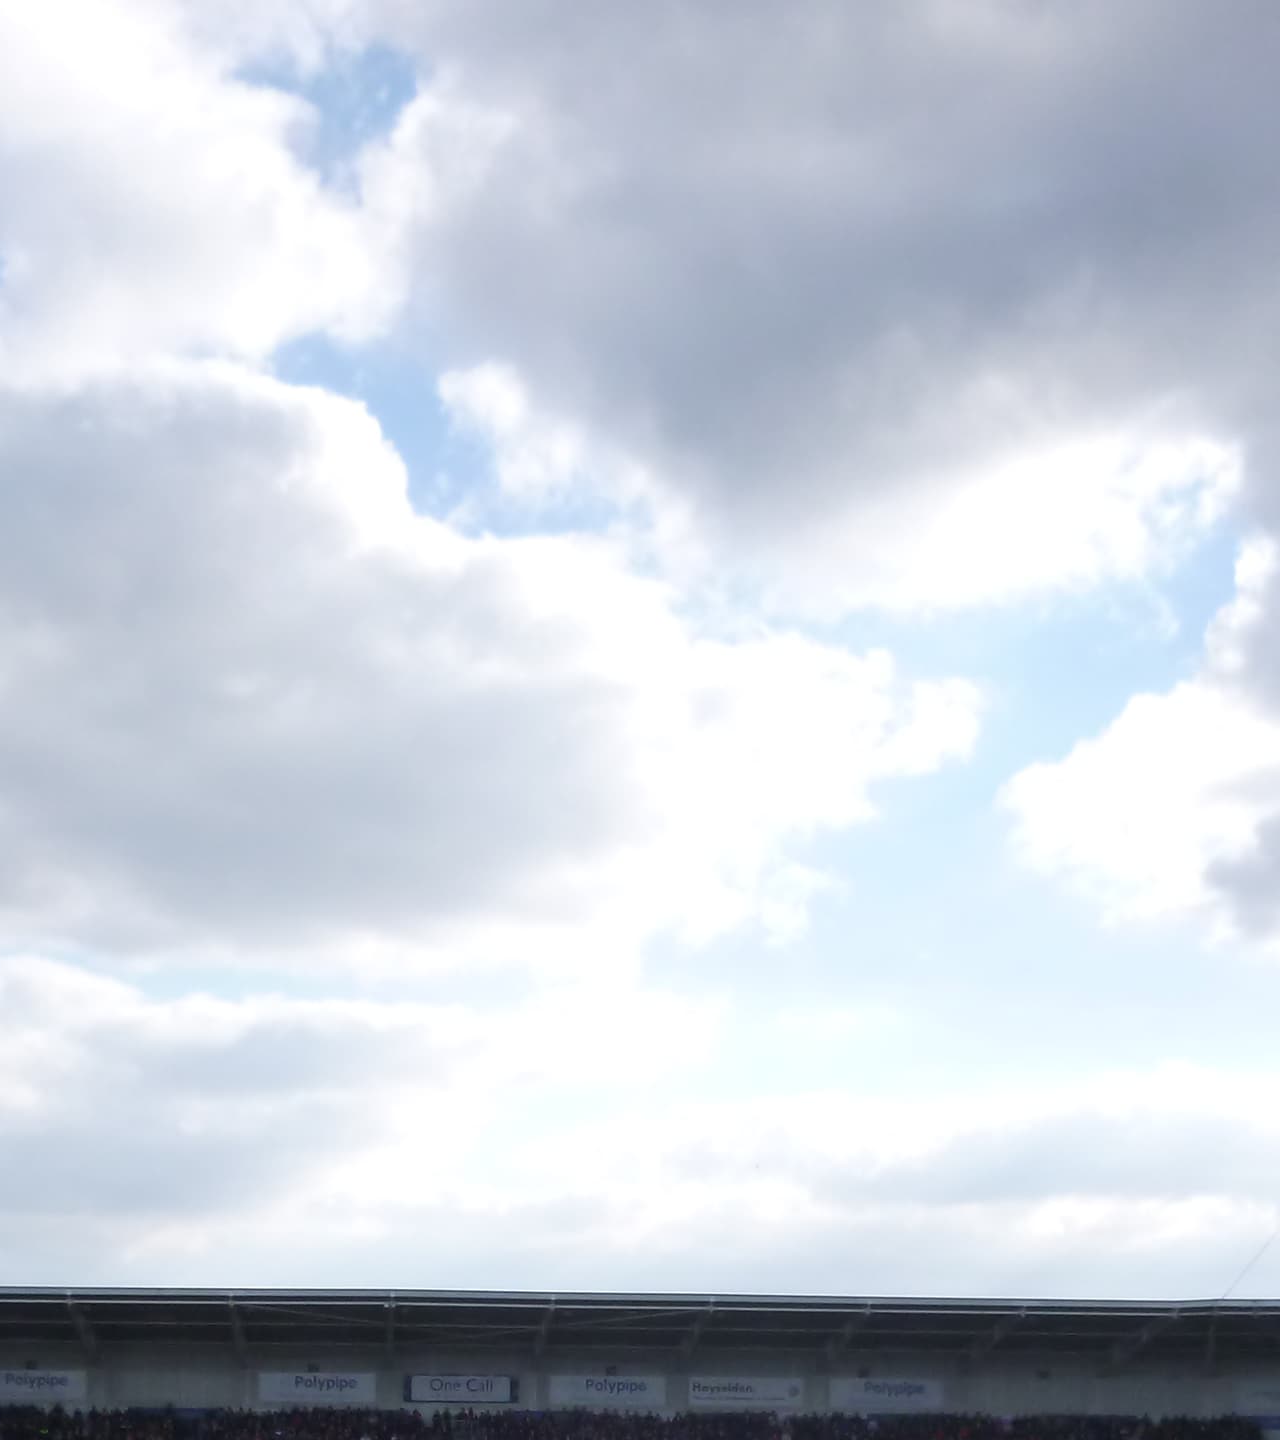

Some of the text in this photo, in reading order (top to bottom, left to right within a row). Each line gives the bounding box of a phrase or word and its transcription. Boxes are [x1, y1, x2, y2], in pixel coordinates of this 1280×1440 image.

[5, 1373, 68, 1389] Polypipe
[294, 1376, 358, 1391] Polypipe
[431, 1378, 494, 1393] One Call
[585, 1378, 648, 1394] Polypipe
